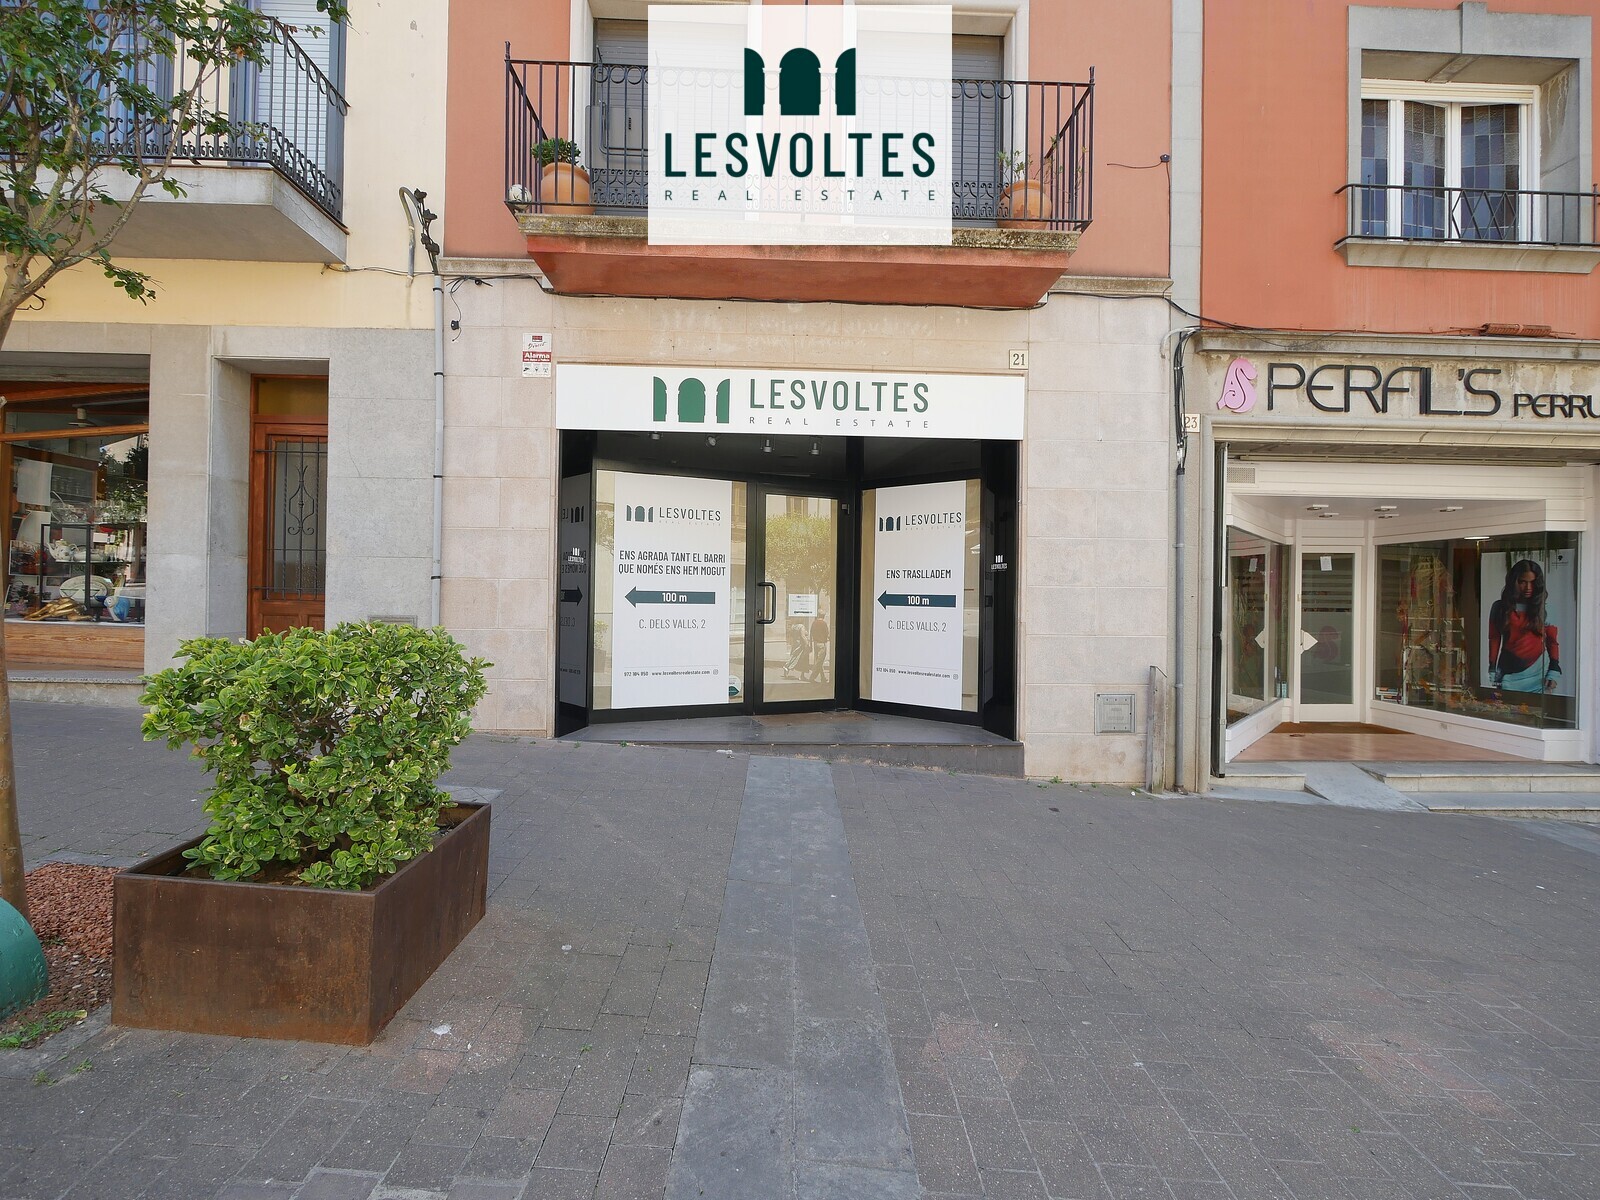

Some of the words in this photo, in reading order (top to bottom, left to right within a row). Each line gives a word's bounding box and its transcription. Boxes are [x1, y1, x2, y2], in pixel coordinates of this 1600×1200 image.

[1012, 352, 1026, 366] 21
[749, 378, 930, 413] LESVOLTES
[749, 416, 809, 427] REAL
[835, 418, 929, 429] ESTATE
[1184, 416, 1198, 429] 23
[659, 506, 721, 522] LESVOLTES
[905, 511, 962, 526] LESVOLTES
[619, 550, 636, 560] ENS
[638, 550, 669, 561] AGRADA
[671, 551, 691, 562] TANT
[693, 552, 702, 563] EL
[704, 553, 726, 563] BARRI
[618, 564, 634, 574] QUE
[636, 562, 664, 575] NOMÉS
[665, 565, 681, 575] ENS
[683, 565, 699, 576] HEM
[700, 566, 726, 576] MOGUT
[886, 569, 900, 579] ENS
[903, 569, 952, 579] TRASLLADEM
[662, 592, 677, 602] 100
[679, 593, 688, 602] m
[907, 595, 920, 605] 100
[922, 597, 930, 605] m
[638, 619, 647, 629] C.
[649, 619, 671, 629] DELS
[672, 619, 699, 630] VALLS,
[701, 619, 706, 629] 2
[888, 620, 895, 630] C.
[896, 620, 914, 630] DELS
[916, 621, 940, 632] VALLS,
[941, 622, 947, 632] 2
